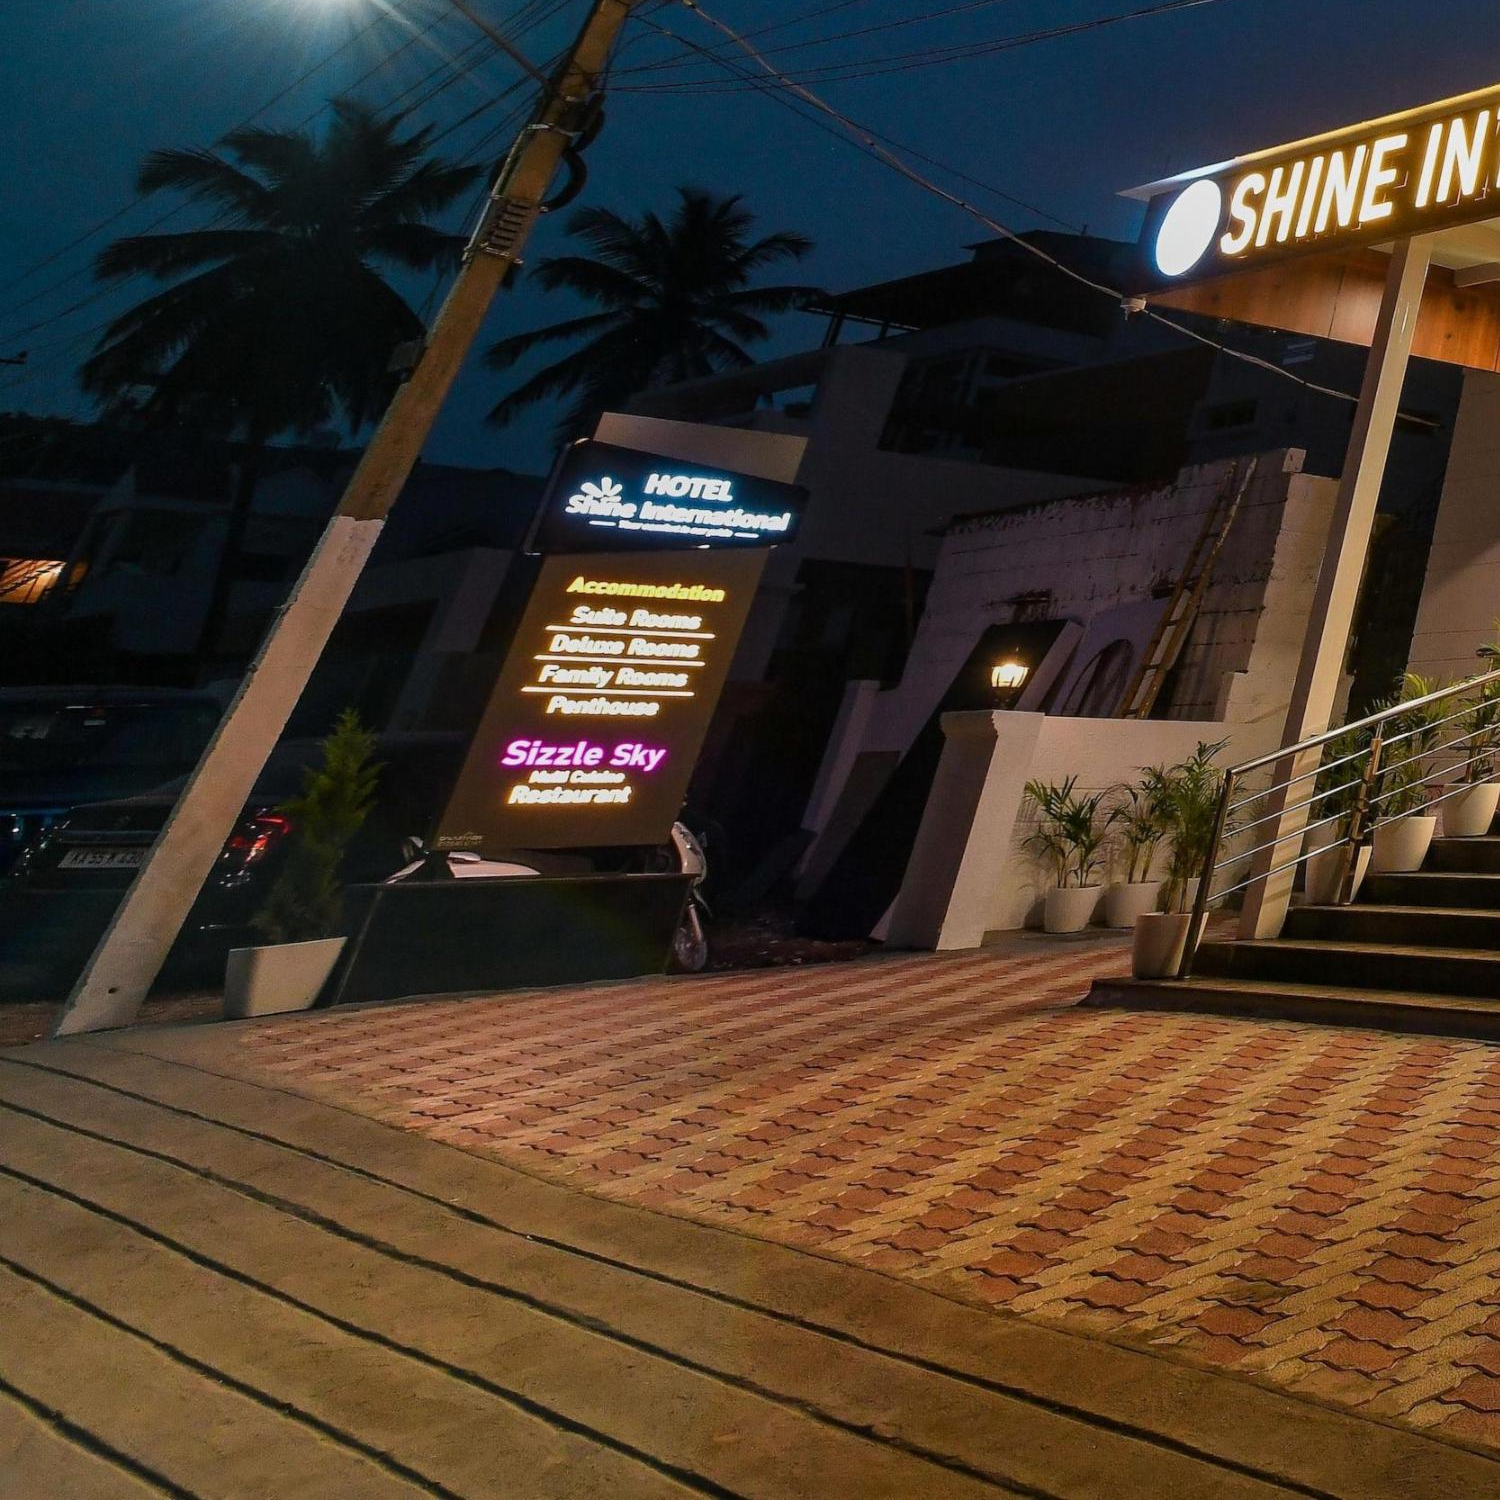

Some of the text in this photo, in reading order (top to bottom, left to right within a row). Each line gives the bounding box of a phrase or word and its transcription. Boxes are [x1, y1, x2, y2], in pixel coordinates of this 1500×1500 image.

[1218, 133, 1407, 257] SHINE
[644, 473, 733, 502] HOTEL
[565, 494, 637, 518] Shine
[639, 501, 791, 532] International
[566, 576, 725, 602] Accommodation
[569, 605, 702, 630] Suite Rooms
[549, 634, 700, 658] Deluxe Rooms
[538, 664, 688, 688] Family Rooms
[546, 695, 660, 717] Penthouse
[501, 739, 667, 772] Sizzle Sky
[508, 785, 632, 804] Restaurant
